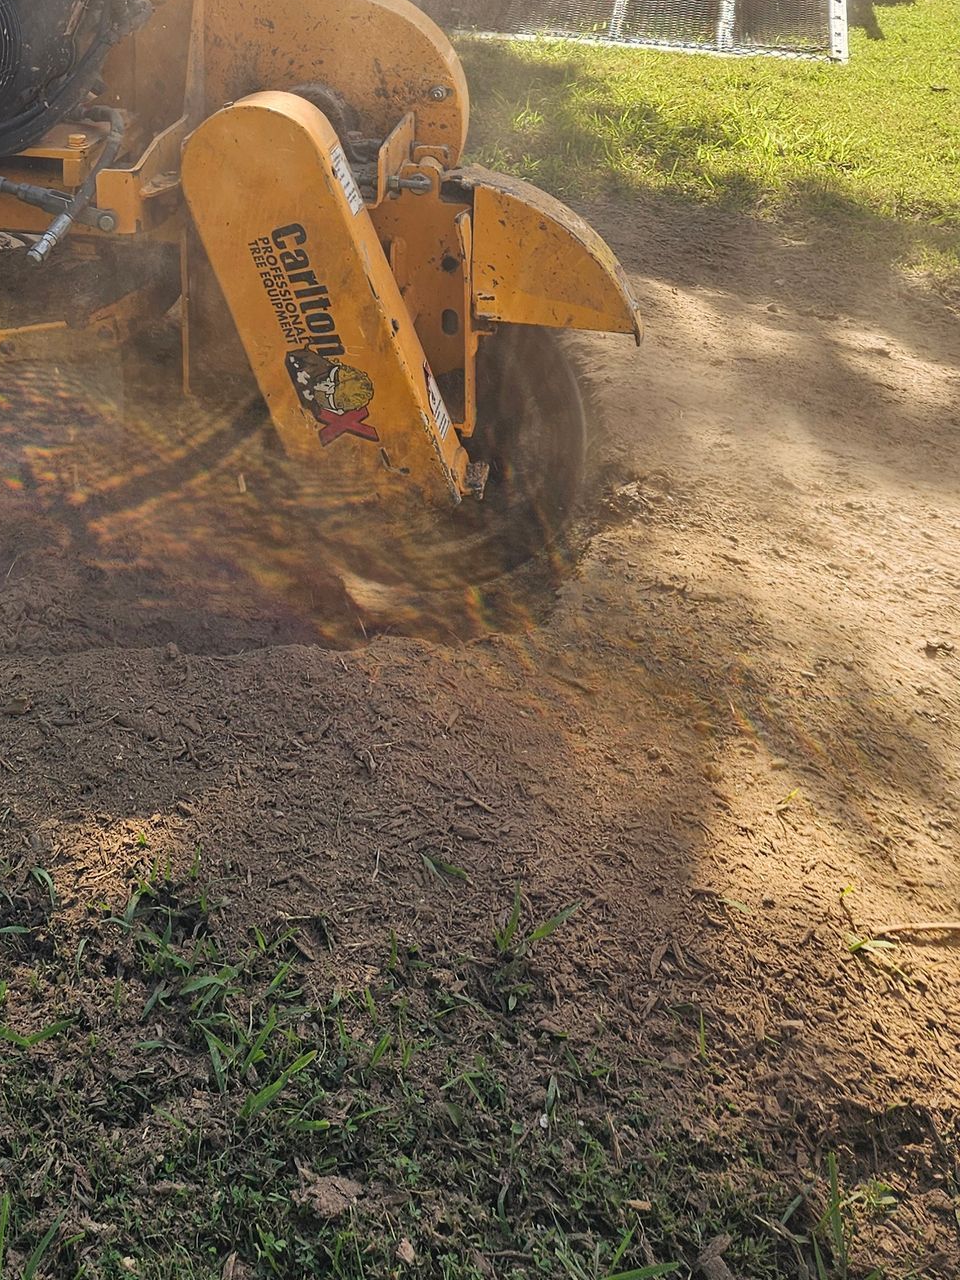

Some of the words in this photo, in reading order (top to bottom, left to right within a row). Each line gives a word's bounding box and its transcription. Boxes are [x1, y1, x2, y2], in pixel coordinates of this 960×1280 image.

[248, 240, 267, 269] TREE
[259, 271, 300, 346] EQUIPMENT
[258, 236, 309, 346] PROFESSIONAL
[271, 223, 345, 357] Carlton
